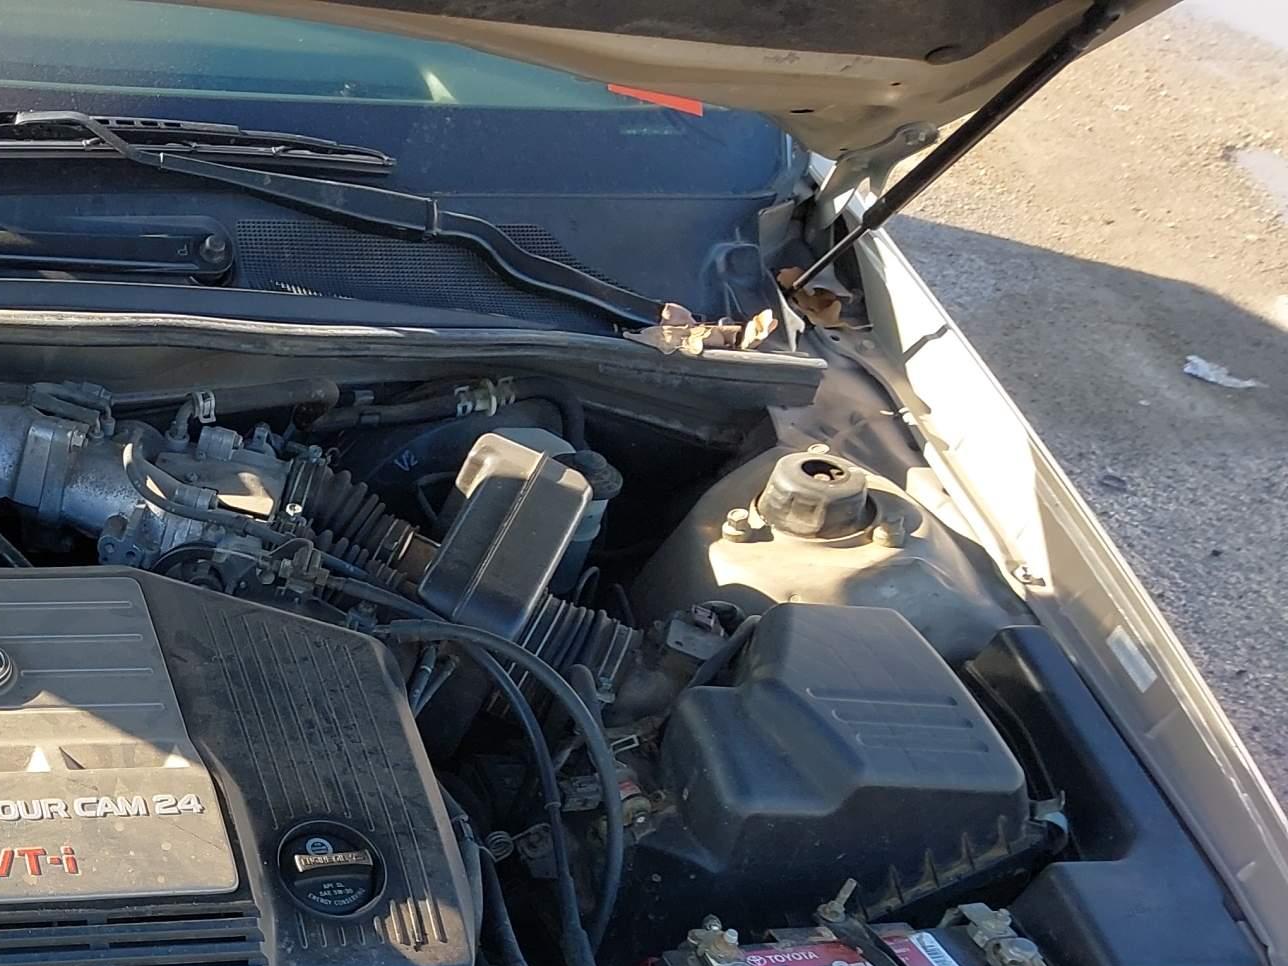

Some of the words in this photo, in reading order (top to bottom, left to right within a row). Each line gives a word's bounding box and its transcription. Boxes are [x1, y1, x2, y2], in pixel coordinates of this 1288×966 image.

[73, 795, 150, 818] CAM
[152, 793, 205, 815] 24
[767, 951, 819, 964] TOYOTA
